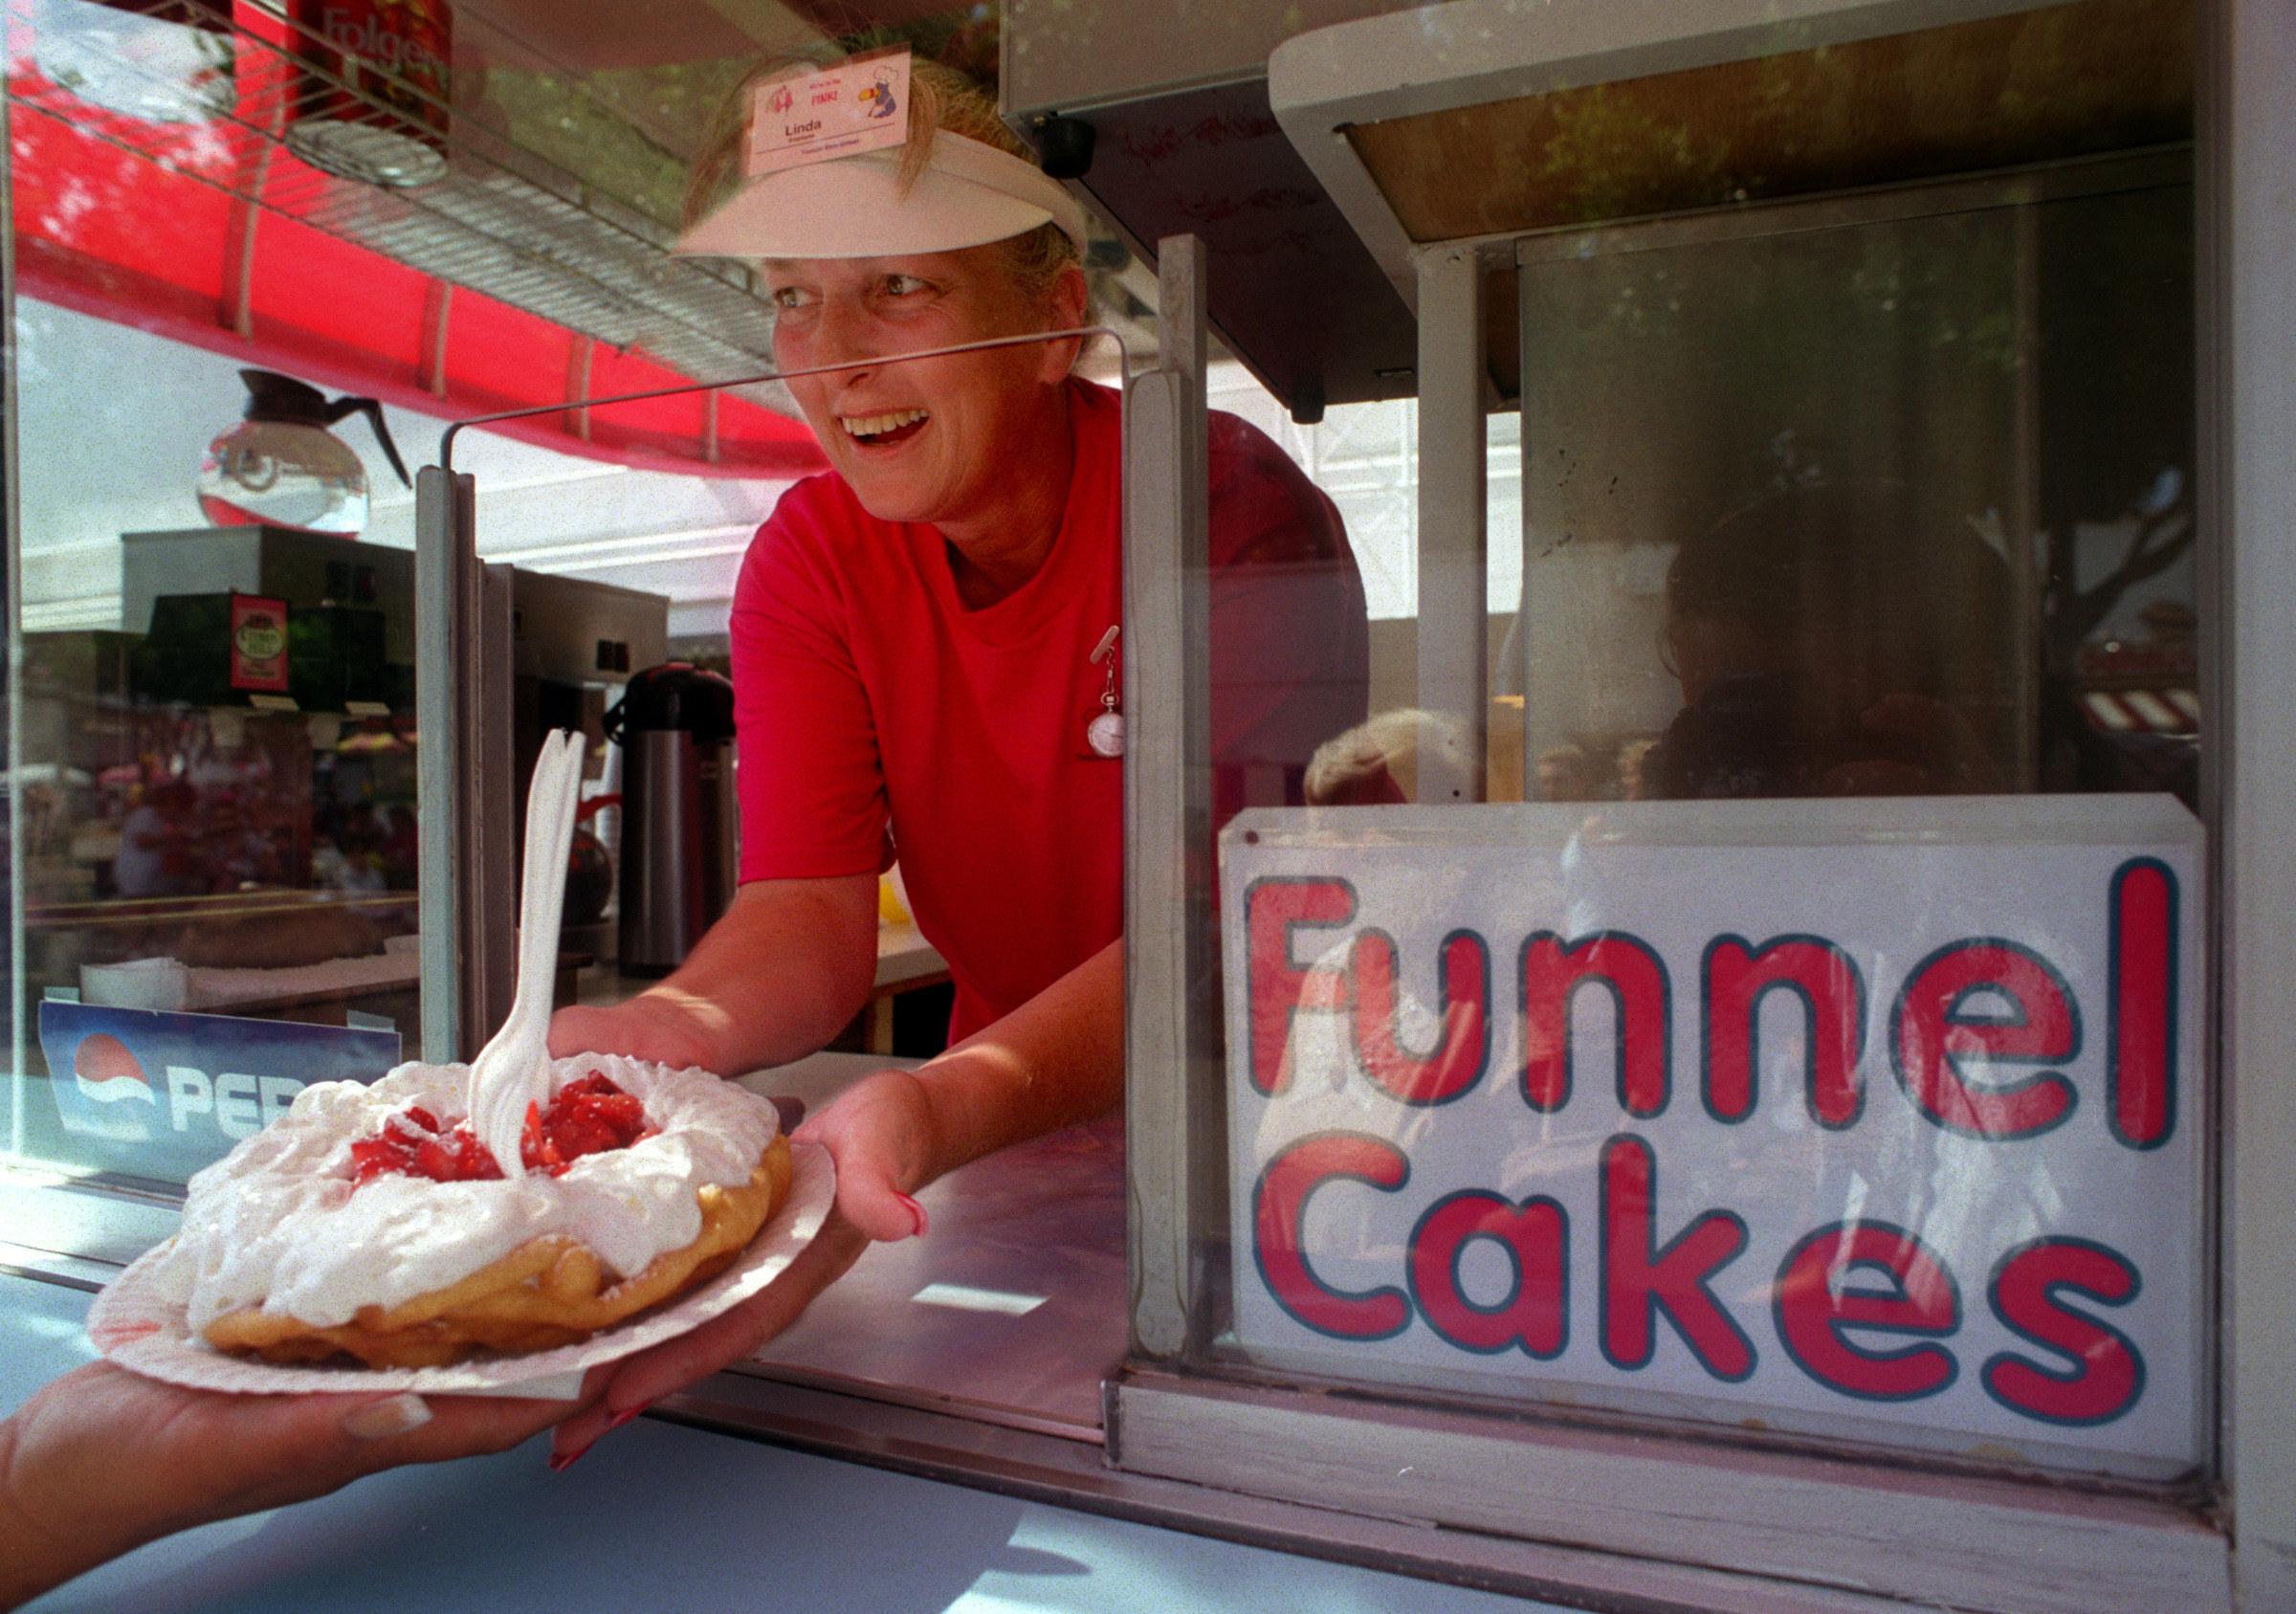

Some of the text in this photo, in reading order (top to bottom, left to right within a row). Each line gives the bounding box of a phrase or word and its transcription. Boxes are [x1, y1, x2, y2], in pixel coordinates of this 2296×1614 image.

[785, 120, 822, 137] Linda
[1244, 856, 2179, 1149] Funnel
[165, 1065, 308, 1140] PEP
[1251, 1130, 2147, 1426] Cakes
